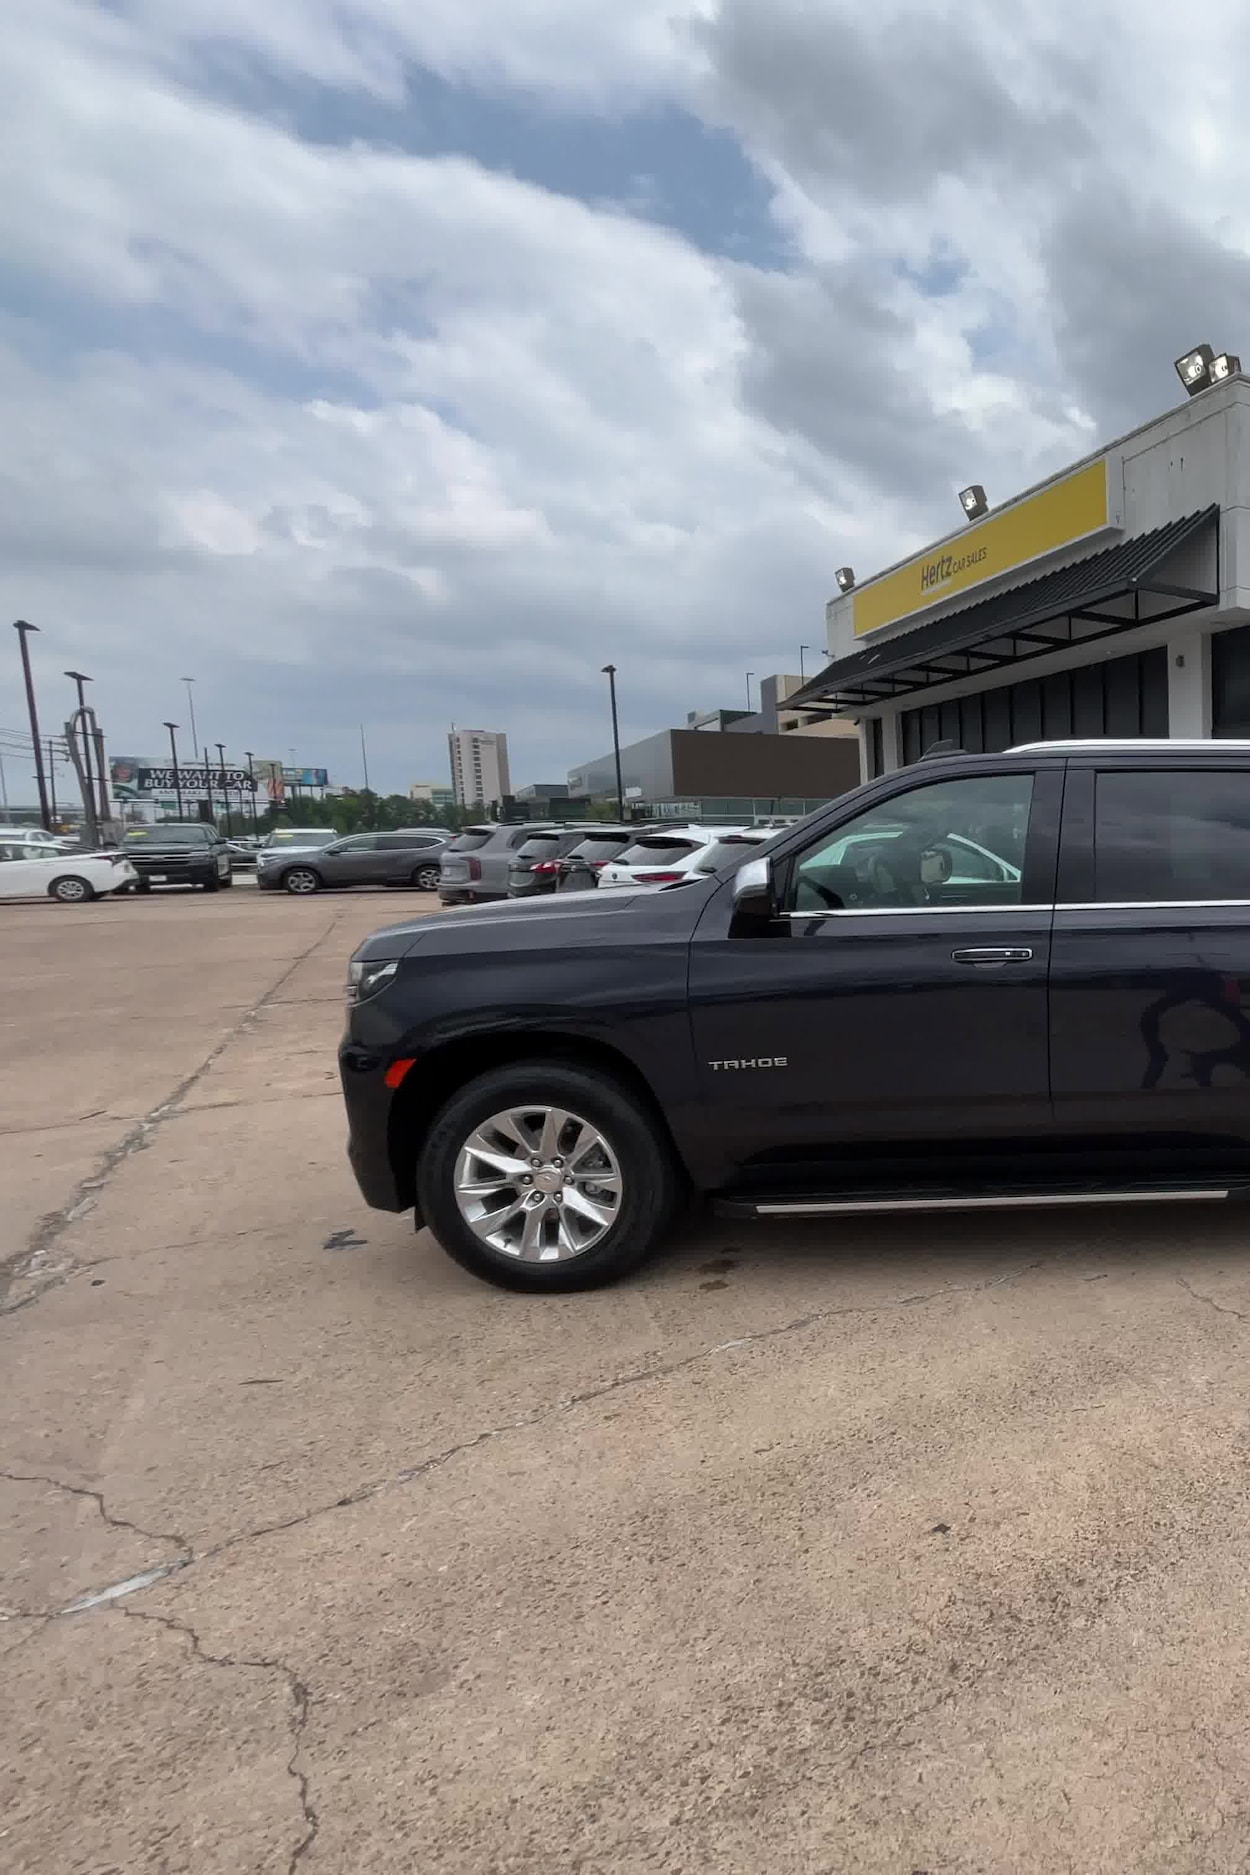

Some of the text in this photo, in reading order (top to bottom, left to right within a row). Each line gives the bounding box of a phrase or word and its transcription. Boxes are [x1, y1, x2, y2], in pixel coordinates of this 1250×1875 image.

[921, 546, 987, 590] Hertz CAR SALES
[150, 770, 244, 780] WE WANT TO
[144, 779, 252, 789] BUY YOUR CAR
[708, 1057, 788, 1070] TAHOE
